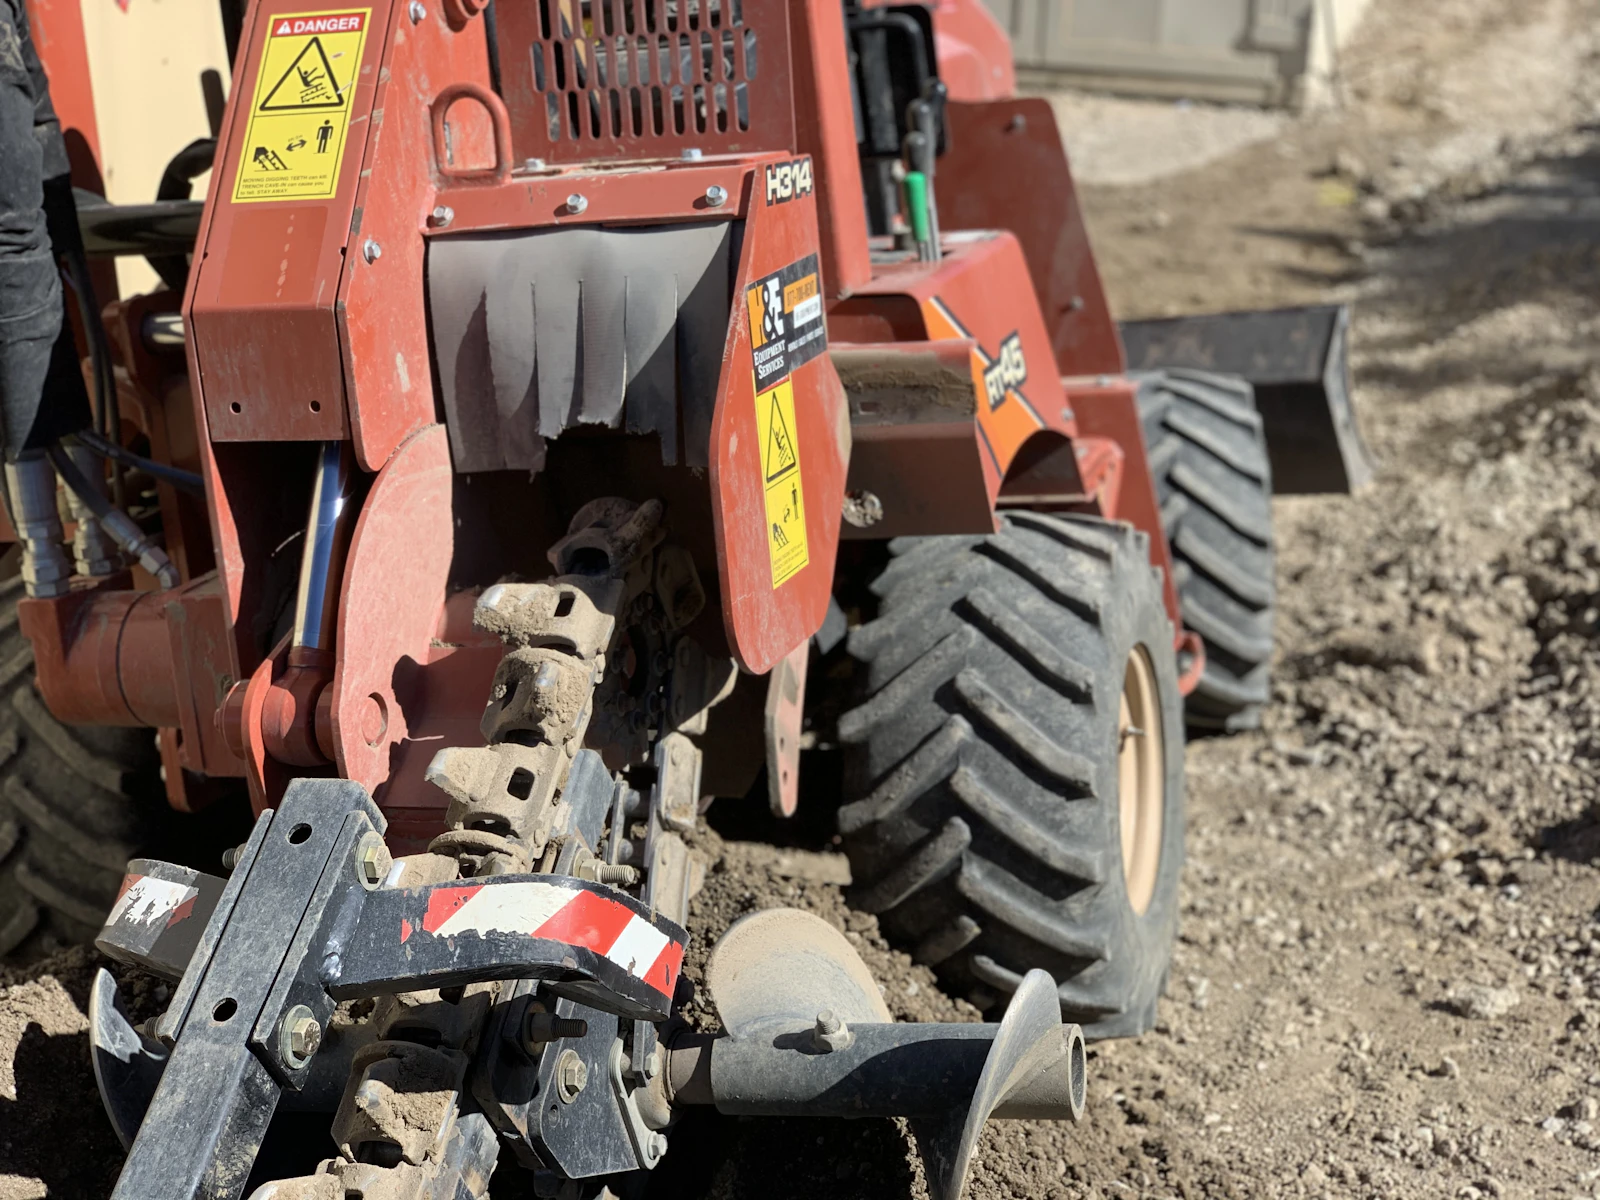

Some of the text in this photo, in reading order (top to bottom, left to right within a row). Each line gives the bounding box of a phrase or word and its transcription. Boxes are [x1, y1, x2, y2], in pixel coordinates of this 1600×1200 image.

[293, 17, 360, 33] DANGER
[766, 160, 812, 202] H314
[747, 277, 785, 350] H&E
[753, 339, 786, 367] EQUIPMENT
[758, 355, 785, 380] SERVICES
[984, 334, 1026, 405] RT45
